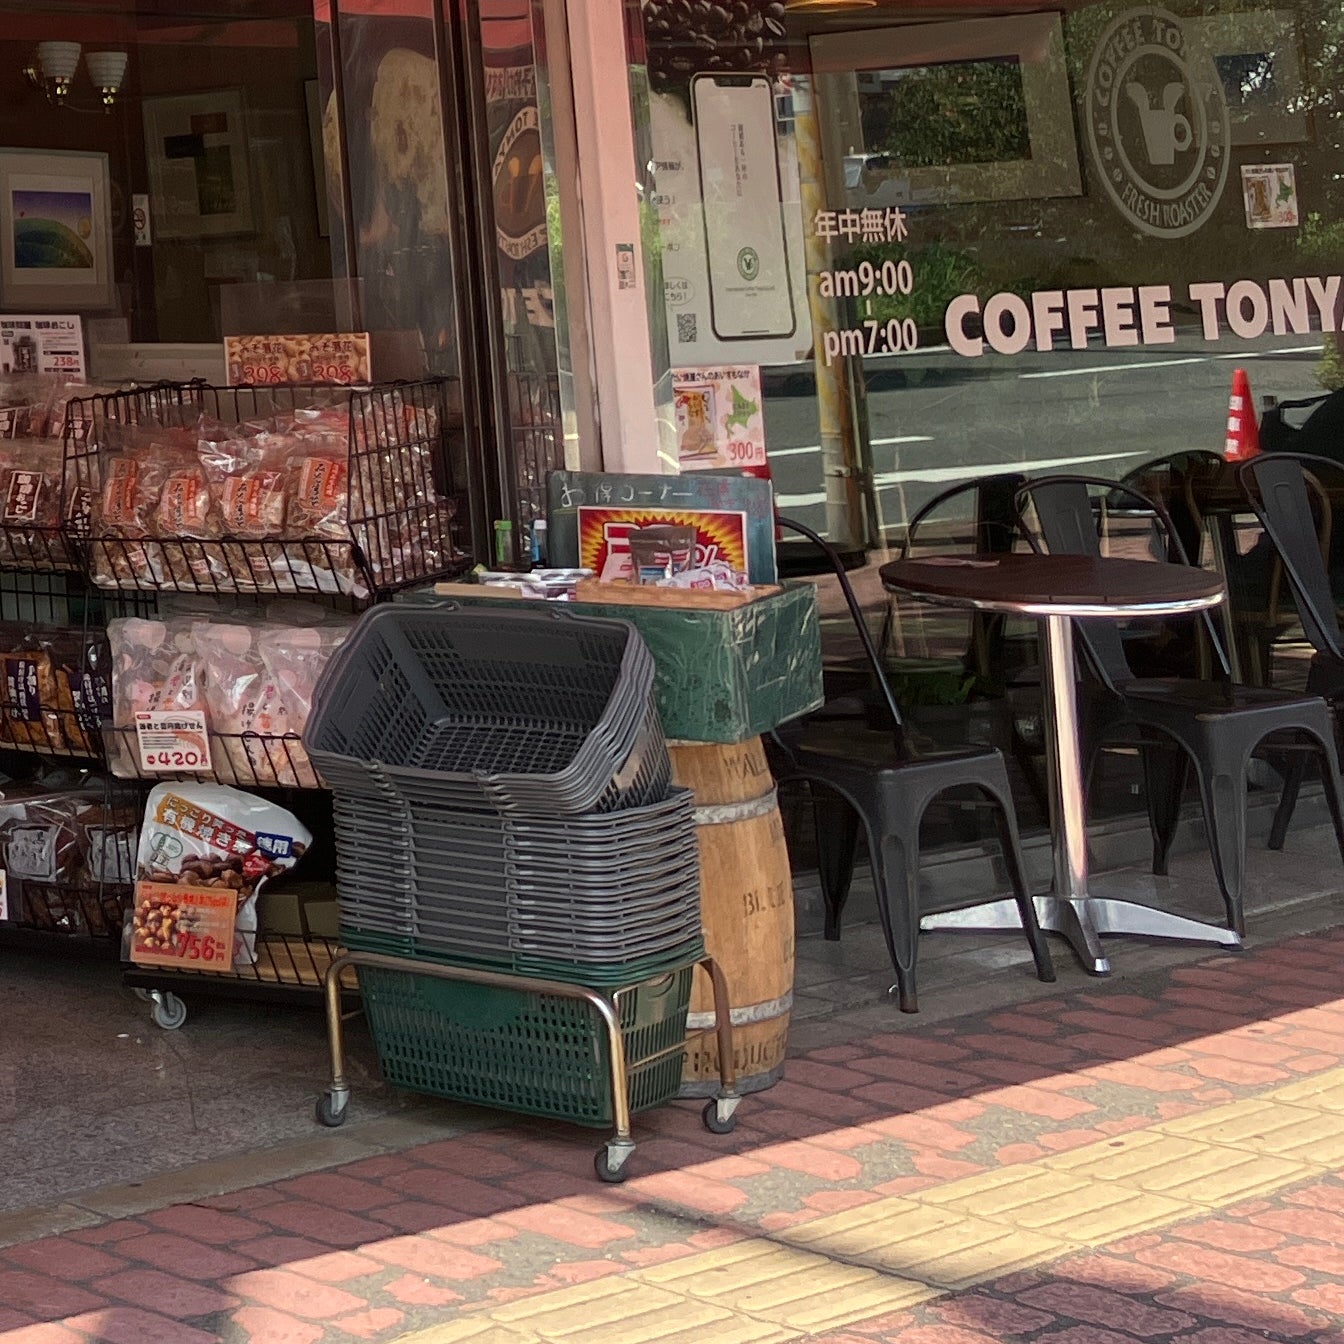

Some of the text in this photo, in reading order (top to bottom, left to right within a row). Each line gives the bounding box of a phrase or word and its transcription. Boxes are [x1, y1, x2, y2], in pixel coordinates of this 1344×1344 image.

[1120, 182, 1214, 227] FRESH ROASTER
[815, 207, 909, 244] 年中無休
[820, 260, 913, 298] am9:00
[945, 274, 1344, 357] COFFEE TONY
[824, 318, 917, 366] pm7:00
[728, 441, 764, 461] 300円
